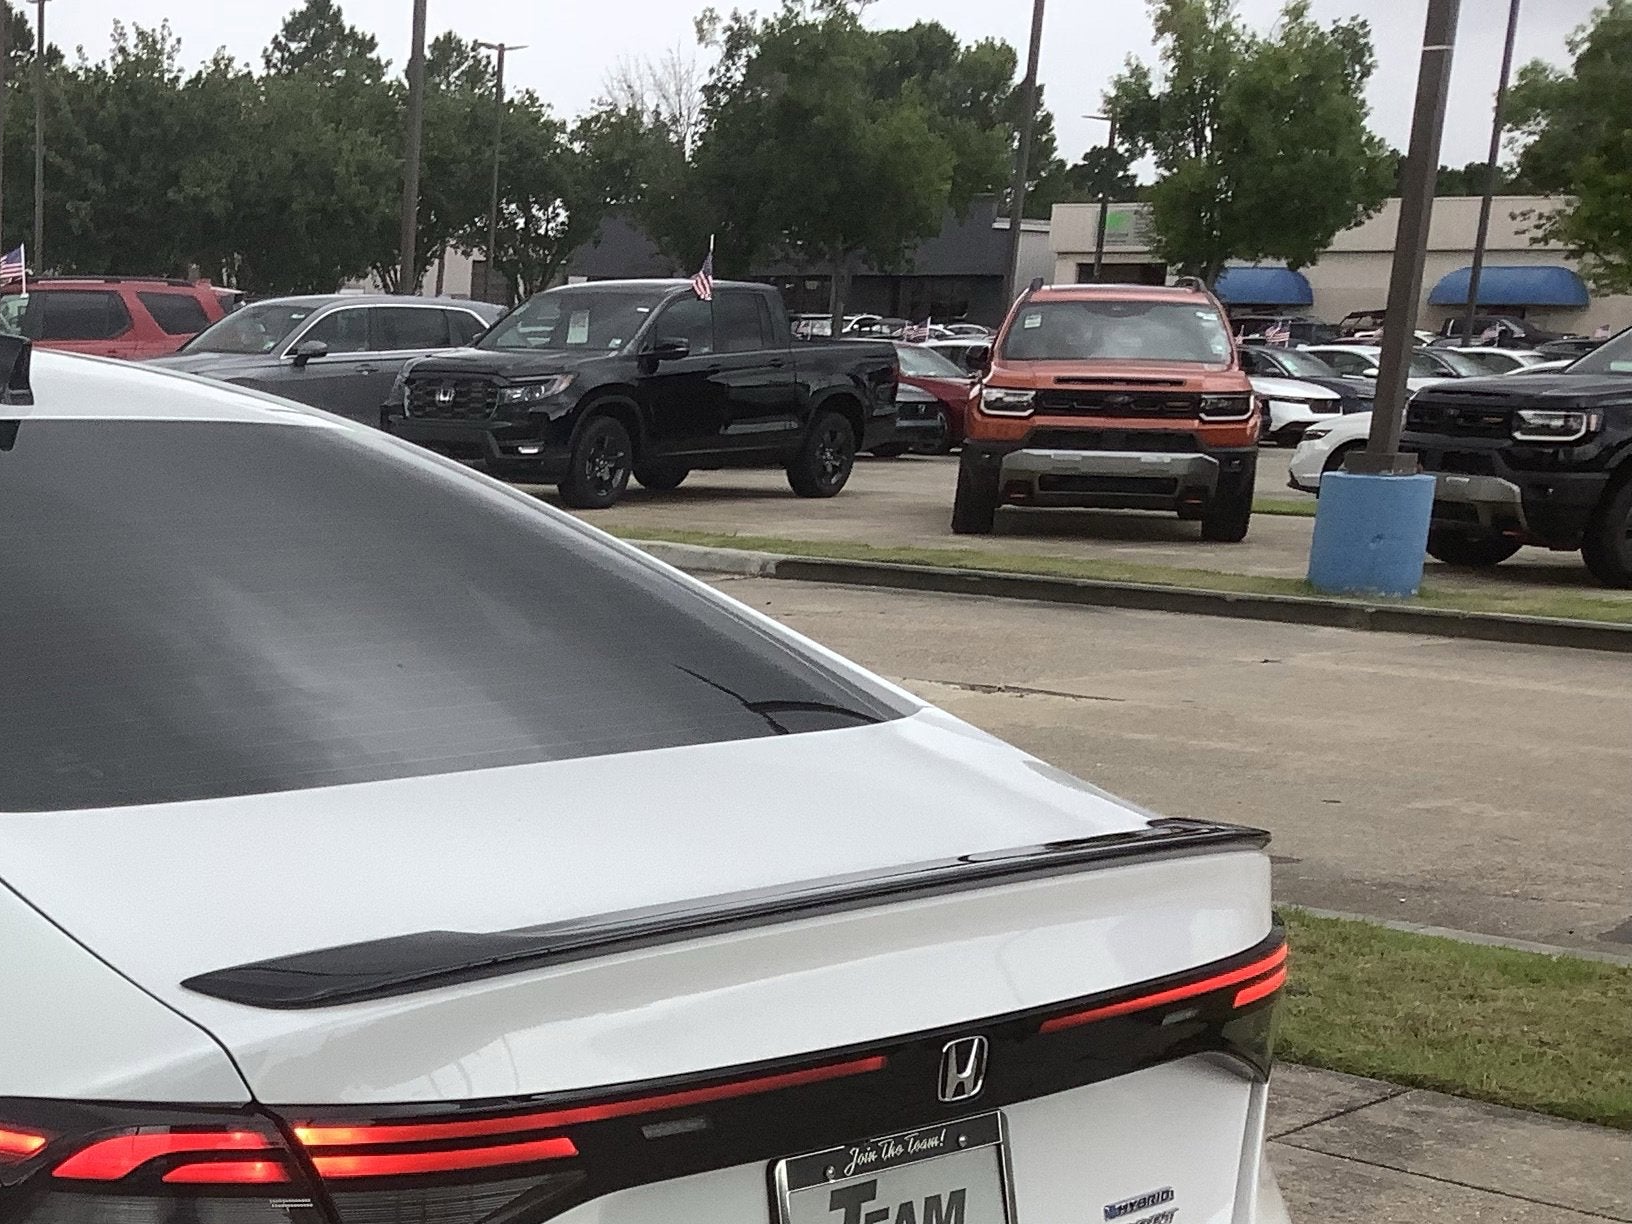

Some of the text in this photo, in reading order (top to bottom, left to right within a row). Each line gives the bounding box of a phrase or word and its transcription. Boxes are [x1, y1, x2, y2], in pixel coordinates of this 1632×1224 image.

[844, 1128, 947, 1177] Join The Team!
[1114, 1188, 1172, 1217] HYBRID
